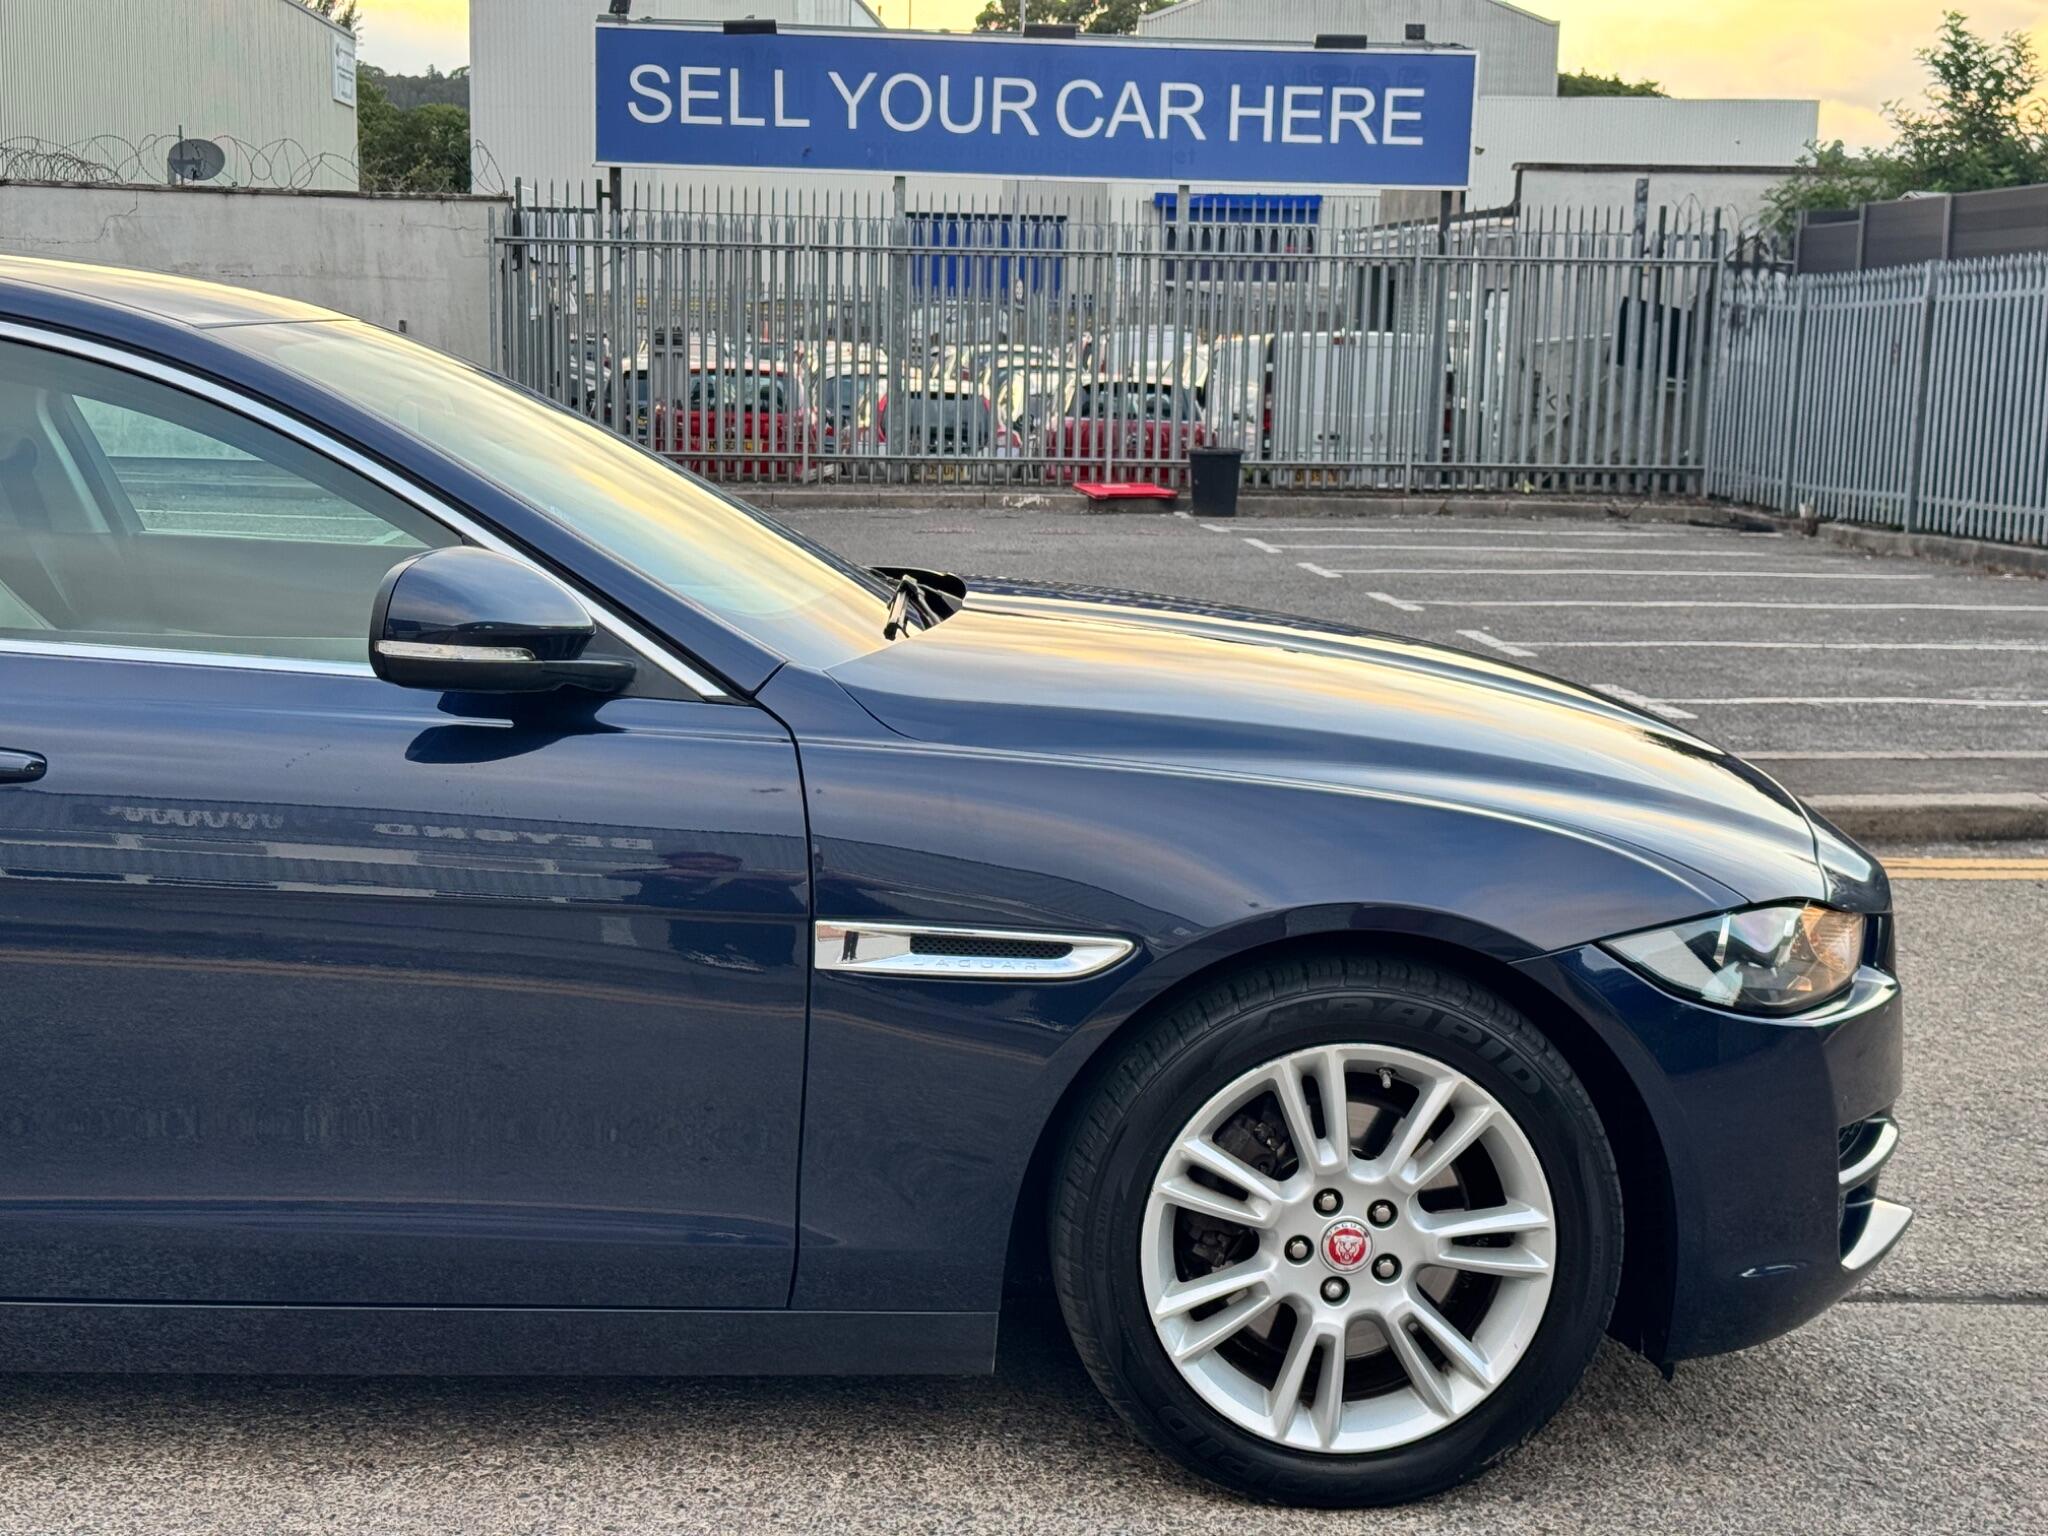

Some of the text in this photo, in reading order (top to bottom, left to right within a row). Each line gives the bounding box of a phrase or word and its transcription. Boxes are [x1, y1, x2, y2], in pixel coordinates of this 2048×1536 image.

[627, 63, 1425, 145] SELL YOUR CAR HERE
[911, 957, 1038, 971] JAGUAR
[1325, 997, 1543, 1095] RAPID
